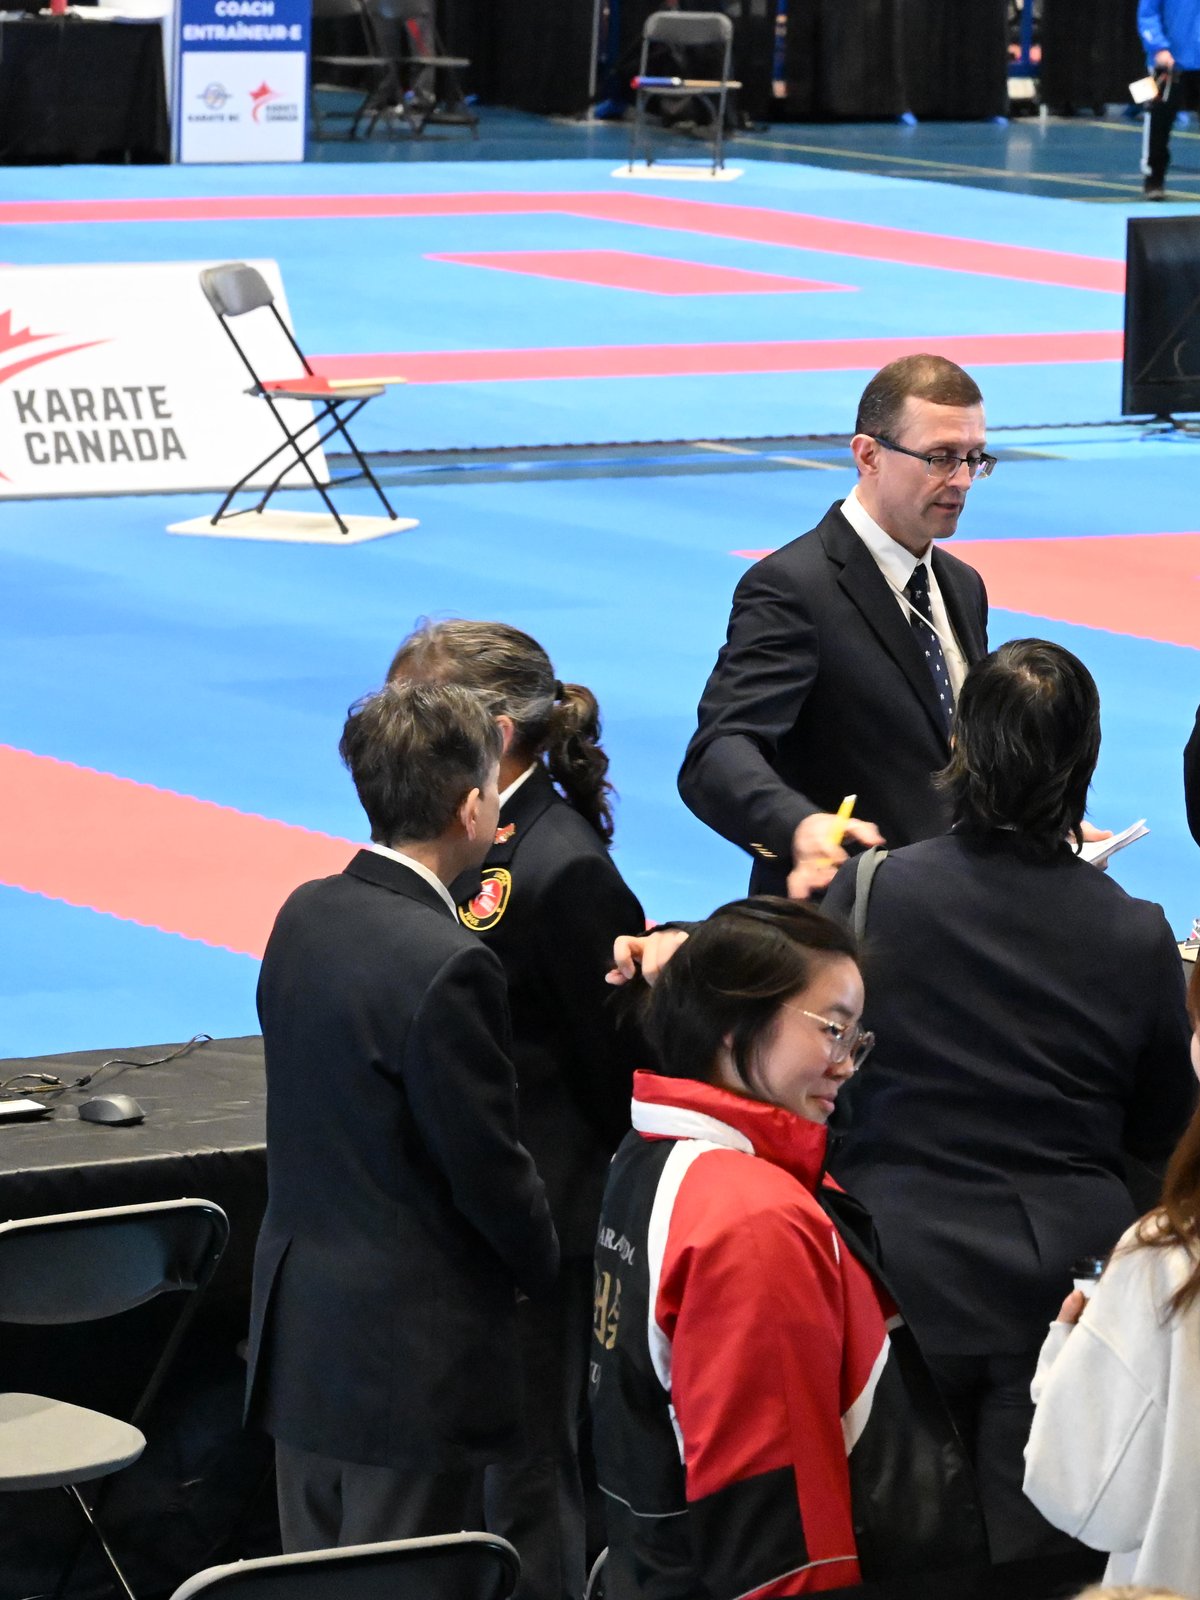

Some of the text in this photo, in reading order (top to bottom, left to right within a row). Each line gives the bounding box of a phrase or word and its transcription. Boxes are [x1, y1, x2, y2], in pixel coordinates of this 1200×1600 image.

[214, 1, 275, 17] COACH
[12, 385, 173, 424] KARATE
[24, 427, 187, 465] CANADA
